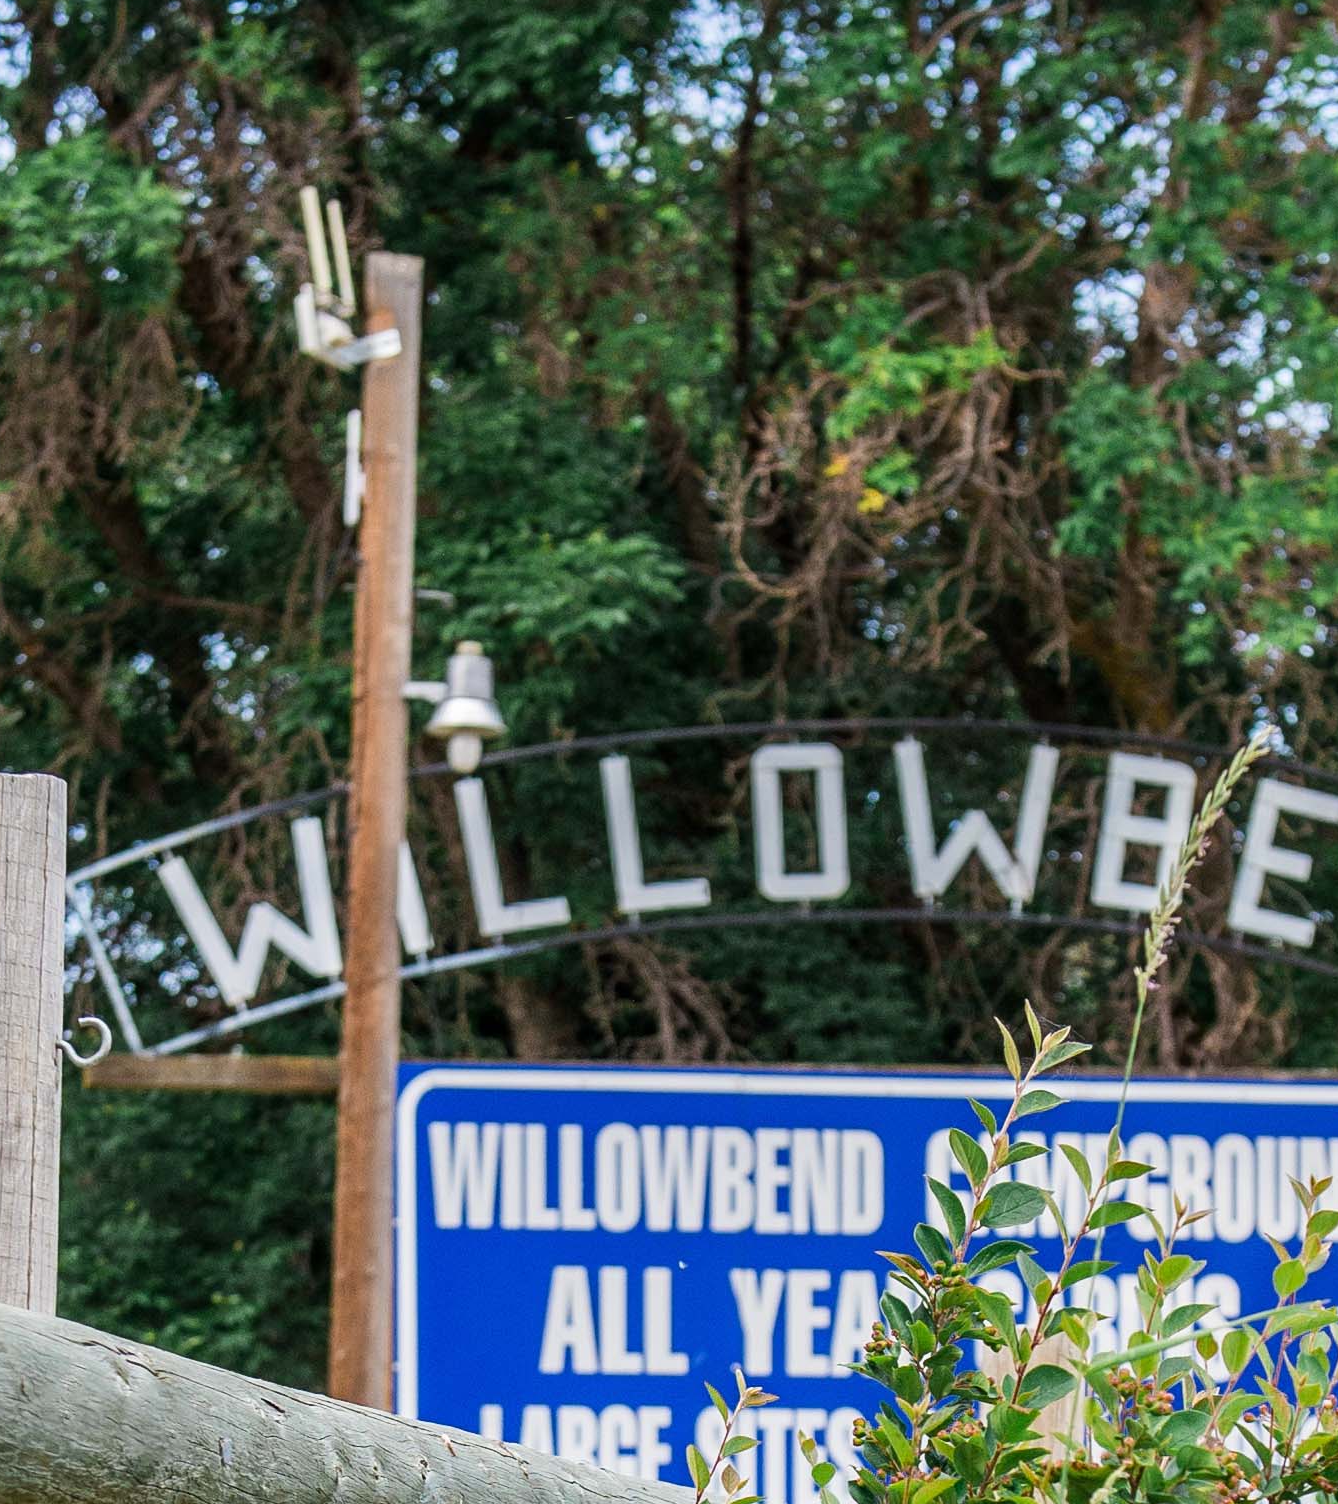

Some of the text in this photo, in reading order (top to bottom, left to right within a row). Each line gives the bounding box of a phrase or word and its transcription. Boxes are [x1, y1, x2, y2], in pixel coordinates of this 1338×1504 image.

[428, 1121, 885, 1238] WILLOWBEND
[538, 1264, 689, 1377] ALL
[728, 1267, 929, 1379] YEA
